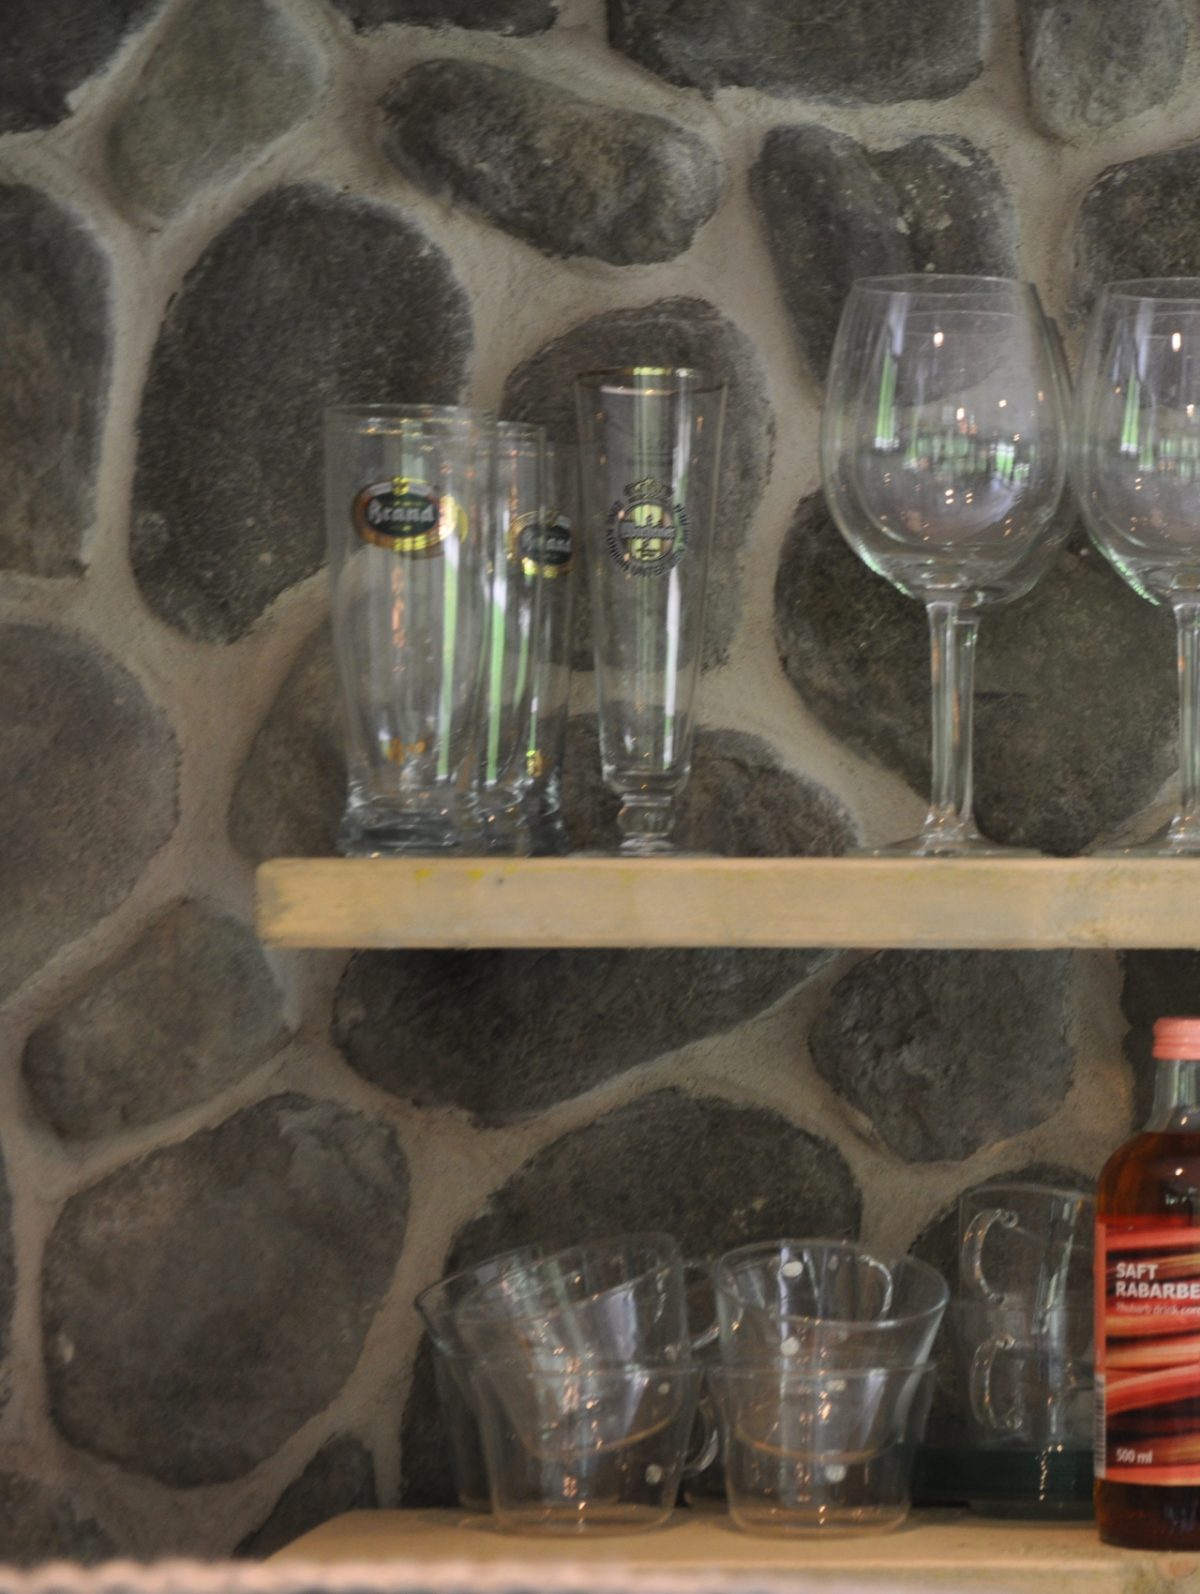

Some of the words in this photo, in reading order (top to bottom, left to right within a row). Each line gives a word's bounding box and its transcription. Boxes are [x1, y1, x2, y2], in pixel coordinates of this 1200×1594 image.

[367, 499, 435, 525] Brand
[1116, 1262, 1159, 1280] SAFT
[1116, 1447, 1135, 1463] 500
[1137, 1449, 1153, 1465] ml
